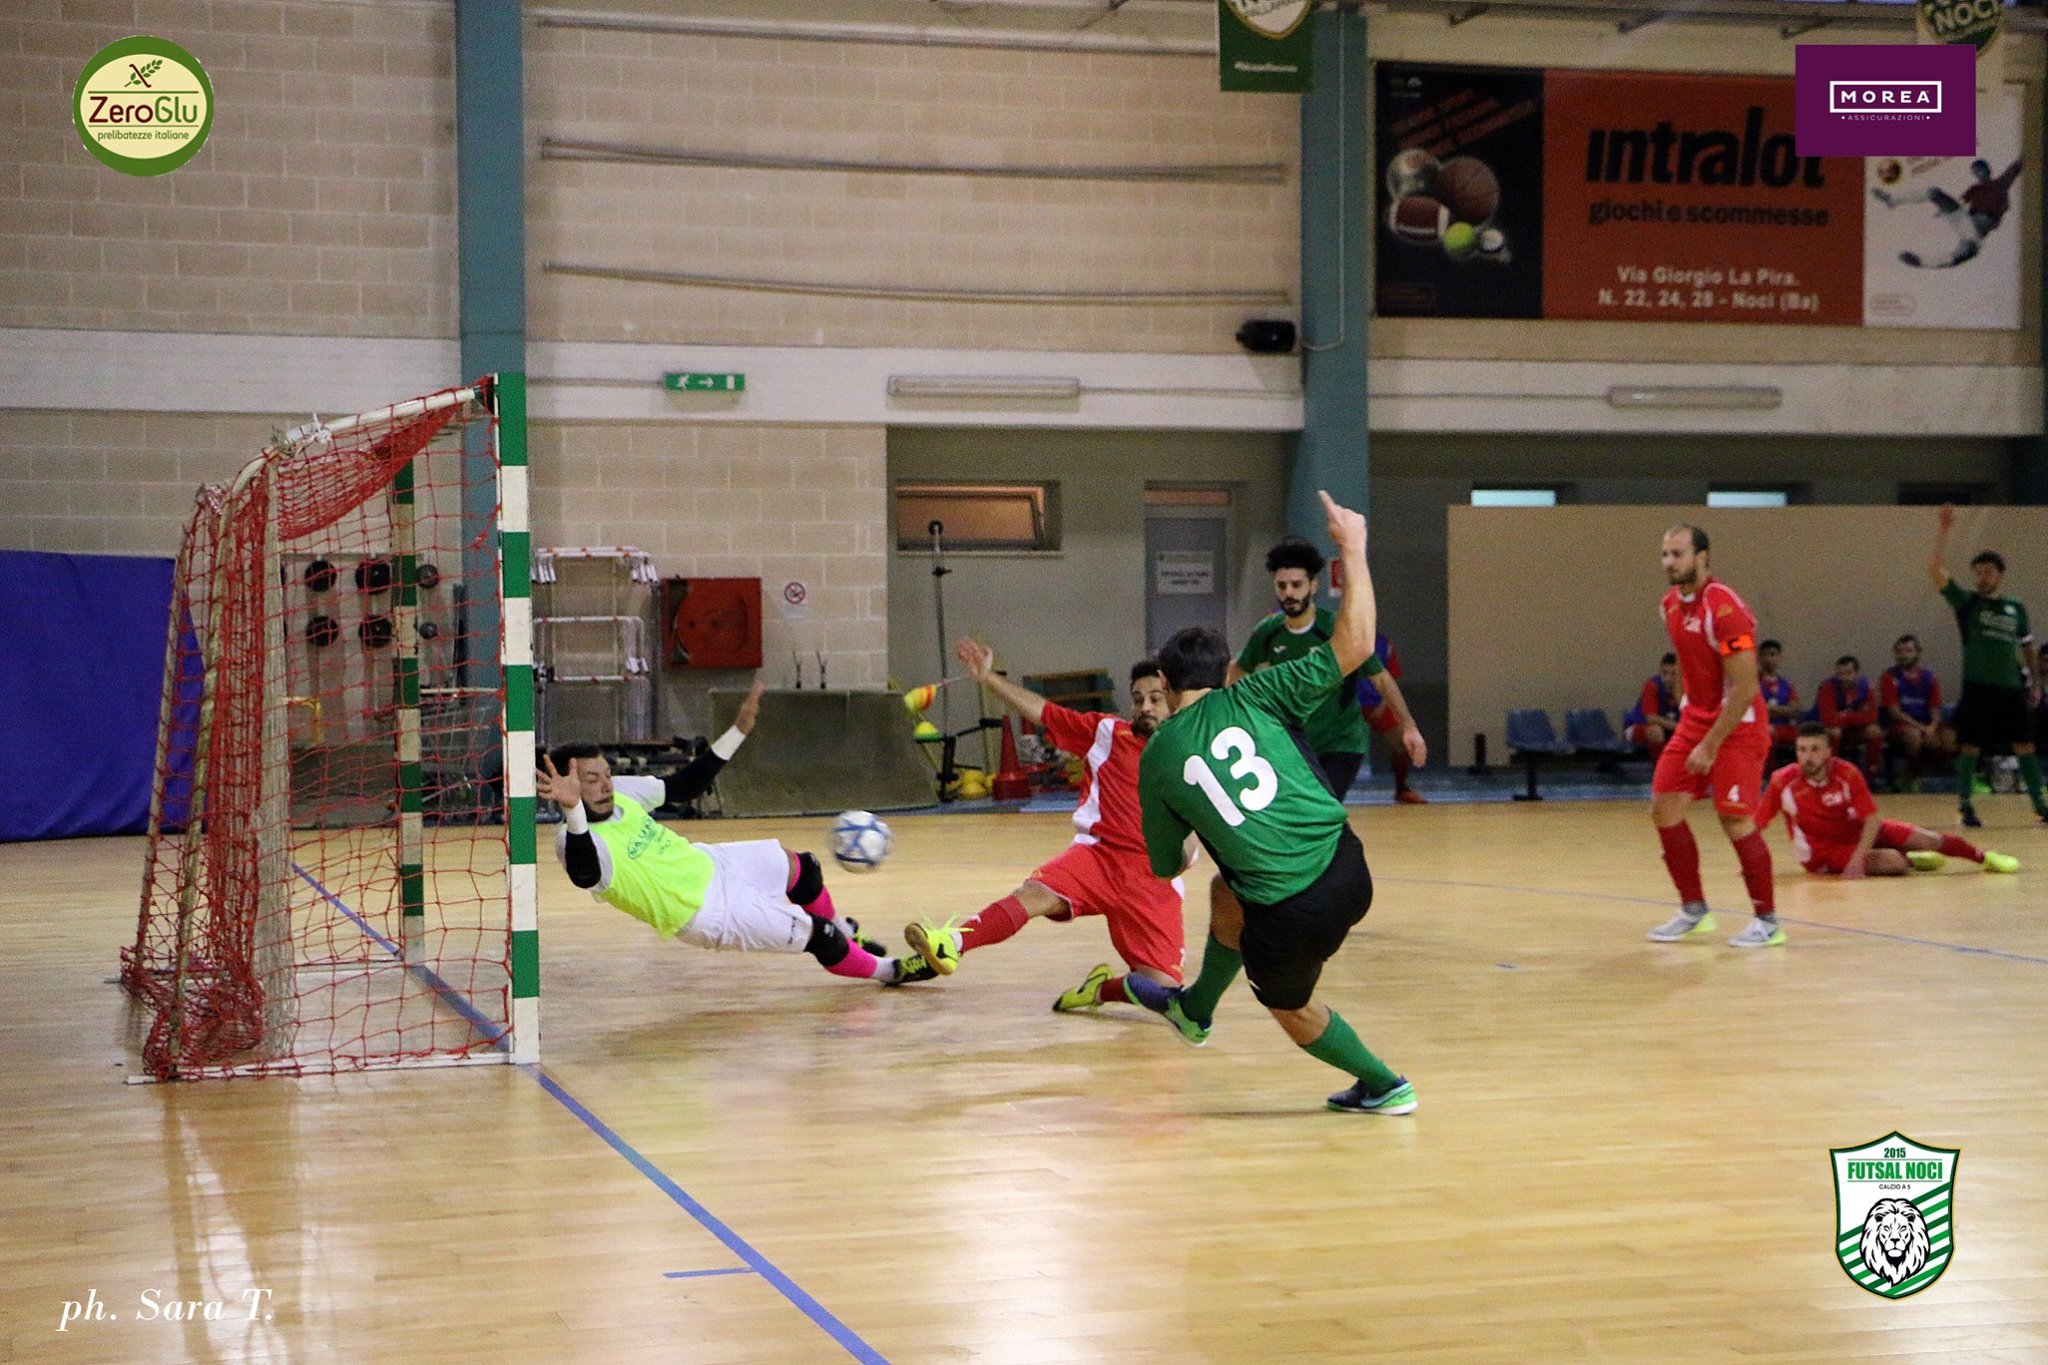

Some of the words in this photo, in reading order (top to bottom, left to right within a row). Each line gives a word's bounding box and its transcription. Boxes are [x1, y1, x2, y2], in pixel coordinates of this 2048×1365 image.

[1588, 199, 1662, 226] giochi
[1687, 204, 1828, 227] scommesse
[1617, 264, 1648, 283] Via
[1653, 265, 1723, 288] Giorgio
[1728, 267, 1751, 285] La
[1733, 291, 1775, 309] Noci
[1183, 726, 1278, 827] 13
